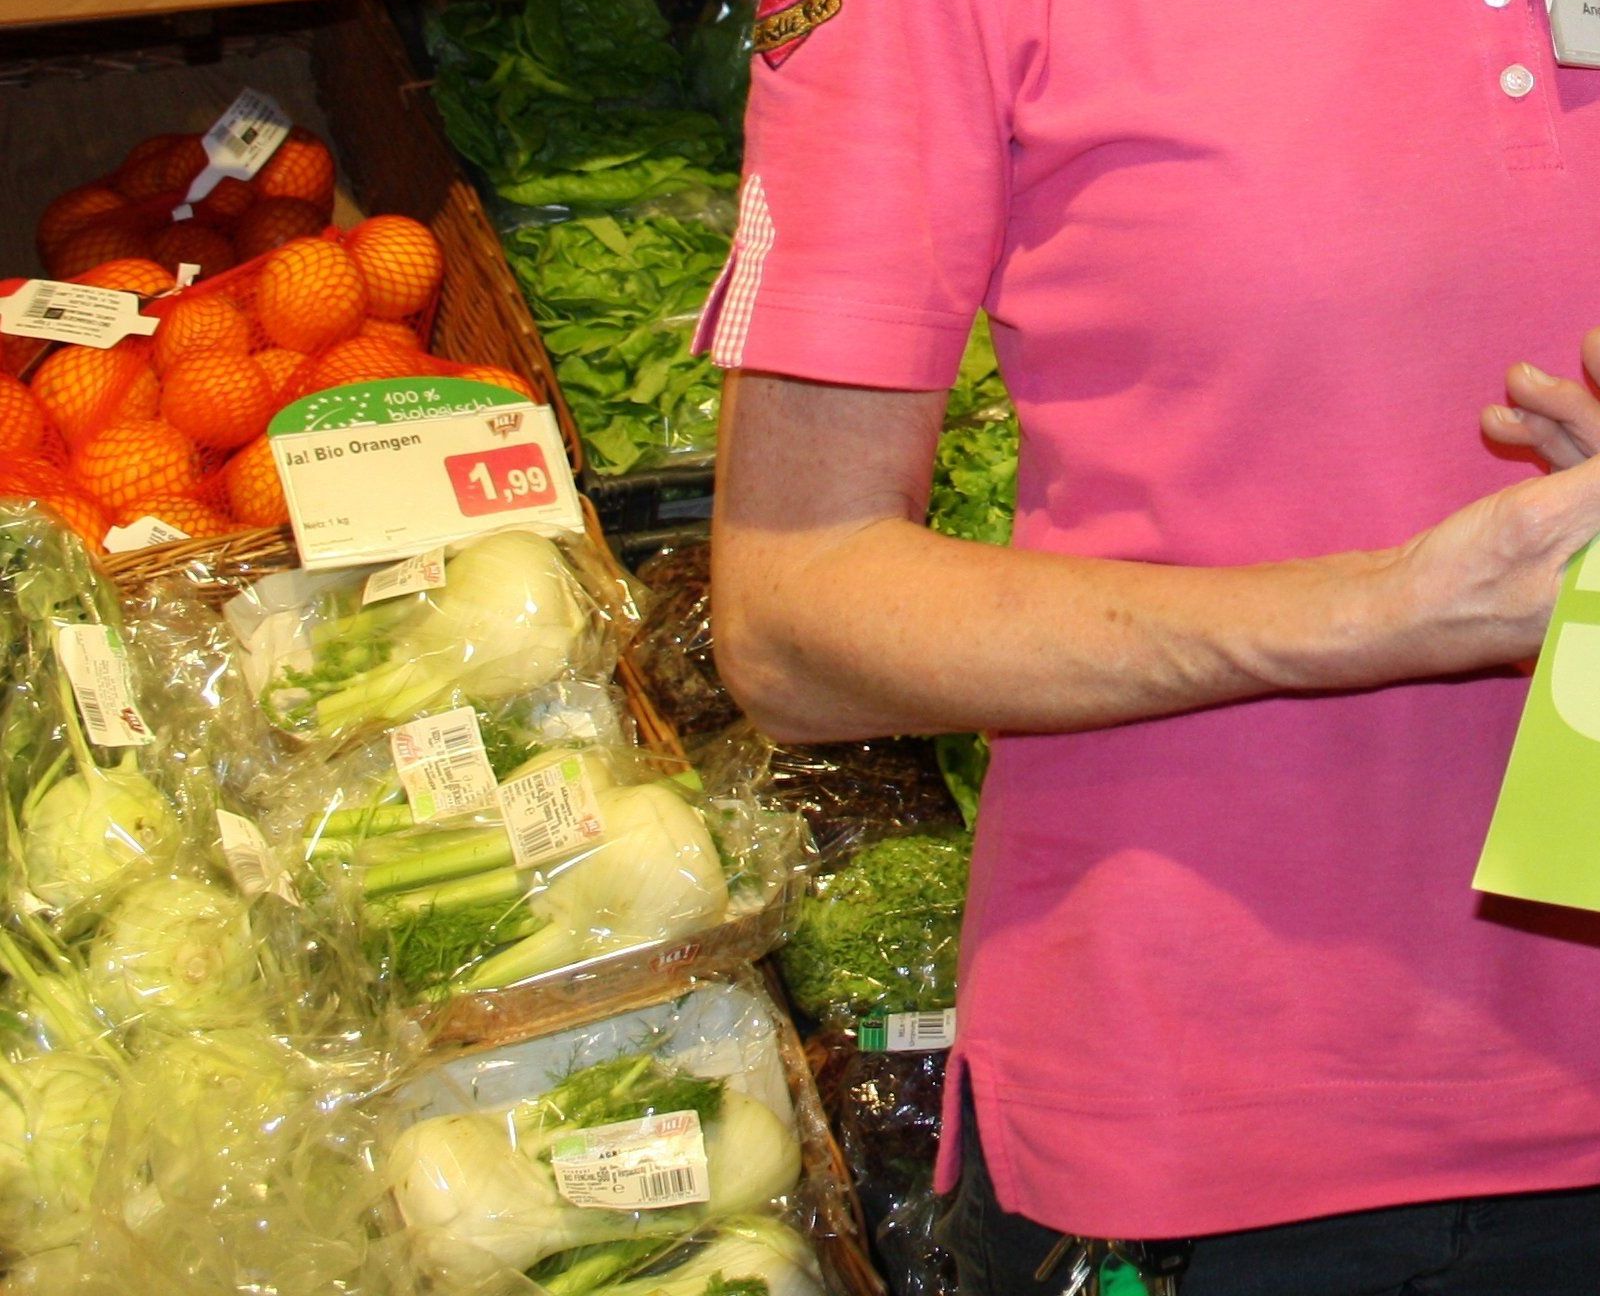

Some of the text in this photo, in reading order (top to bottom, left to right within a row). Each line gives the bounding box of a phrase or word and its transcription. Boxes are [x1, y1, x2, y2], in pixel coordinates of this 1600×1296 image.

[384, 388, 441, 405] 100 %
[286, 433, 422, 467] Ja! Bio Orangen
[467, 461, 548, 504] 1,99
